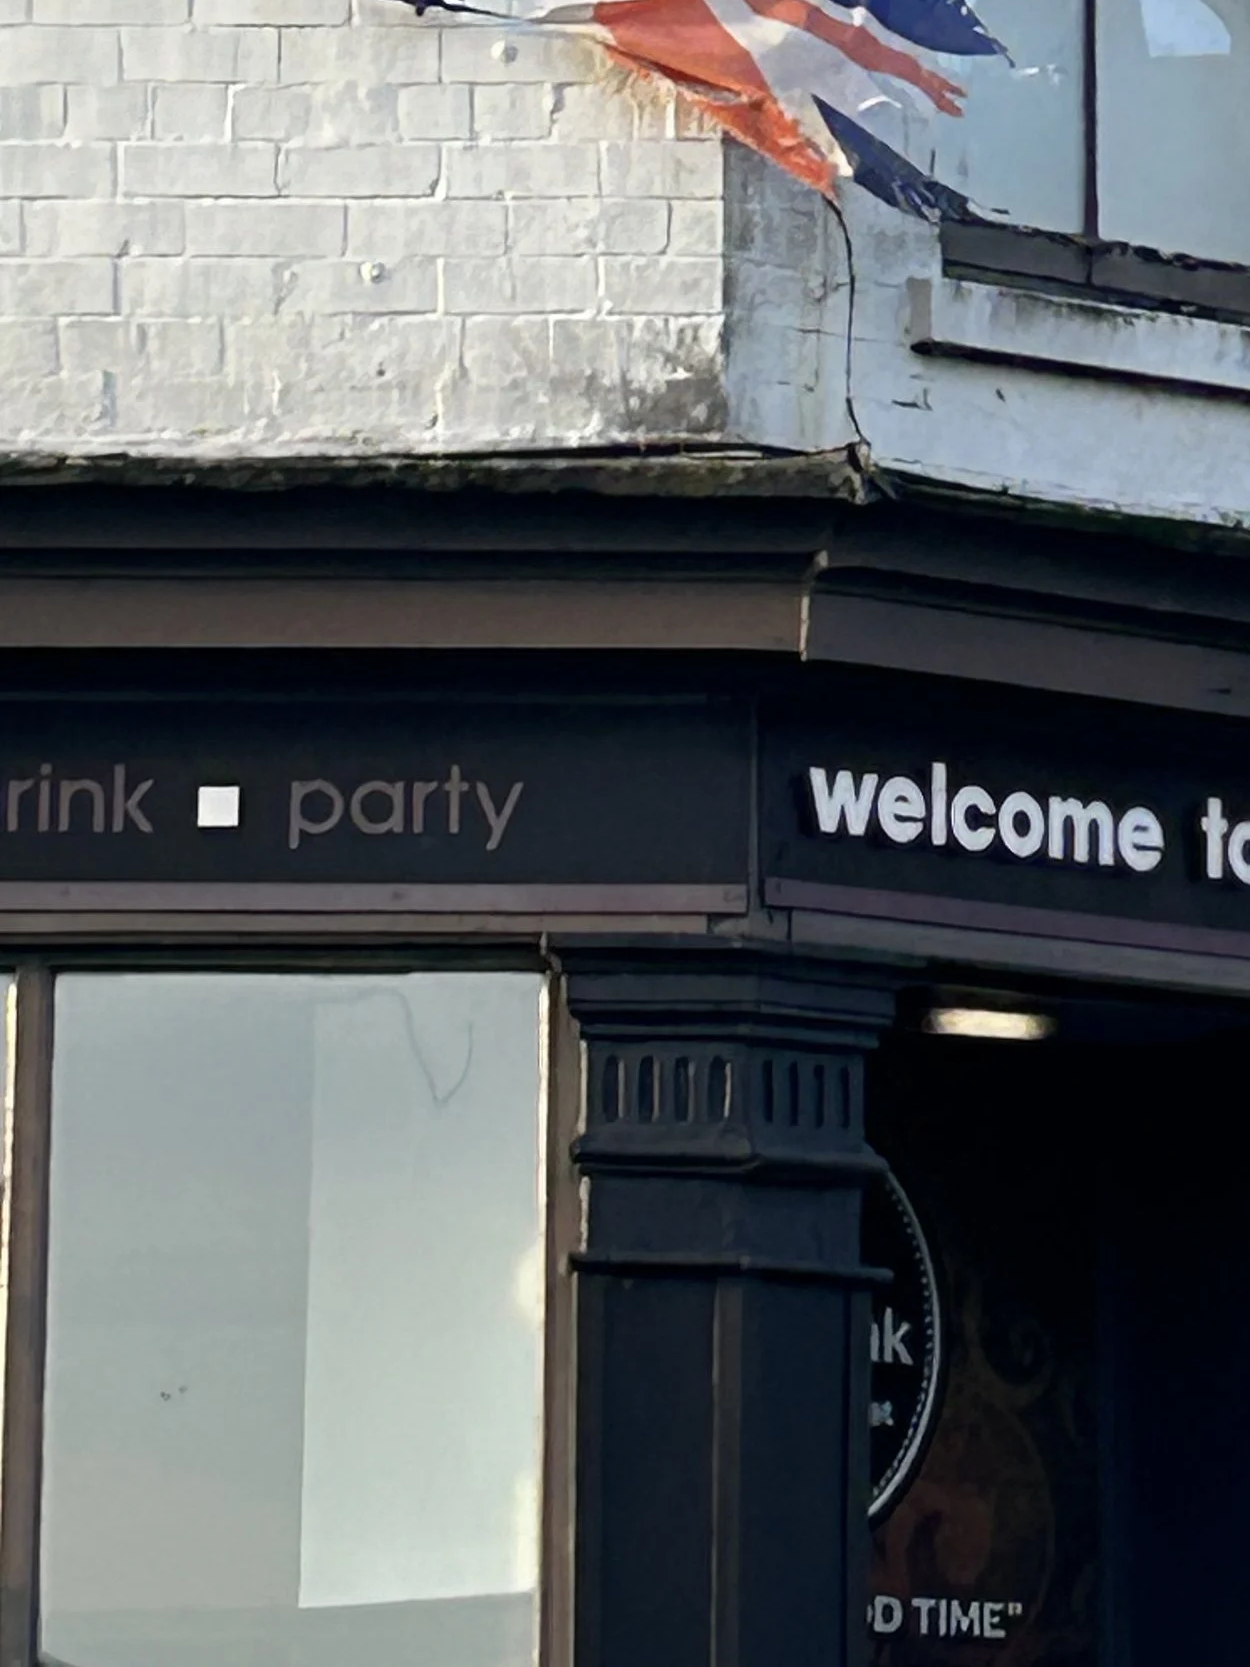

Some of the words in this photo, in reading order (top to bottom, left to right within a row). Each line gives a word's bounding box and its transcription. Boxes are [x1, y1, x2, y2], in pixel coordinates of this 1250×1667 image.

[6, 764, 154, 833] rink
[288, 764, 525, 851] party
[808, 762, 1165, 873] welcome
[865, 1595, 903, 1633] D
[911, 1597, 1023, 1639] TIME"
